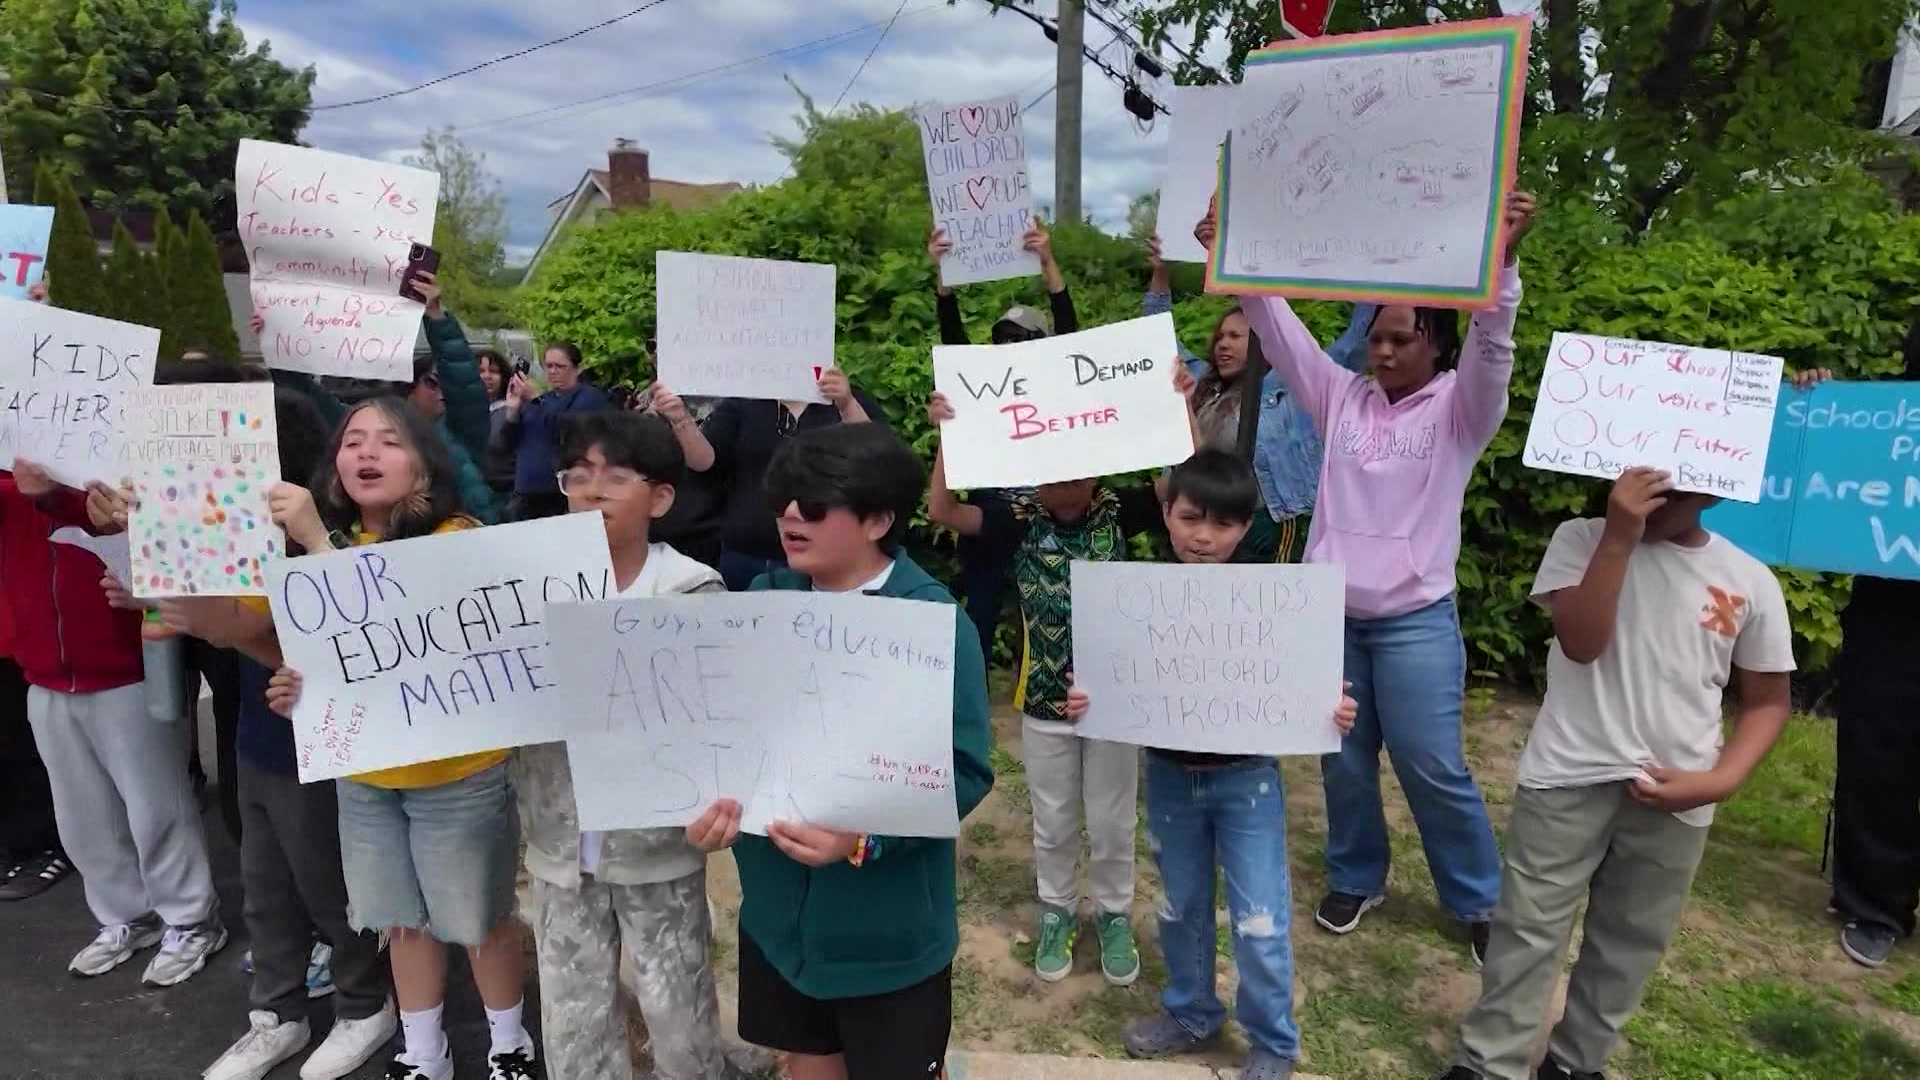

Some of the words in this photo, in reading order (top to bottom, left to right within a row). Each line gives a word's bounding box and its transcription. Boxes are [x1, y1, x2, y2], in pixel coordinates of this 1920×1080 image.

[923, 110, 960, 143] WE
[252, 159, 339, 204] Kids
[372, 178, 419, 214] Yes
[242, 211, 334, 239] Teachers
[384, 254, 404, 282] Ye
[958, 366, 1028, 400] WE
[1065, 354, 1154, 386] DEMAND
[1000, 404, 1120, 440] BETTER
[1531, 446, 1574, 465] We
[1805, 471, 1891, 507] Are
[284, 552, 407, 635] OUR
[1112, 575, 1209, 622] OUR
[1231, 575, 1313, 616] KIDS
[1147, 621, 1279, 653] MATTER
[399, 642, 558, 726] MATTE
[604, 643, 738, 734] ARE
